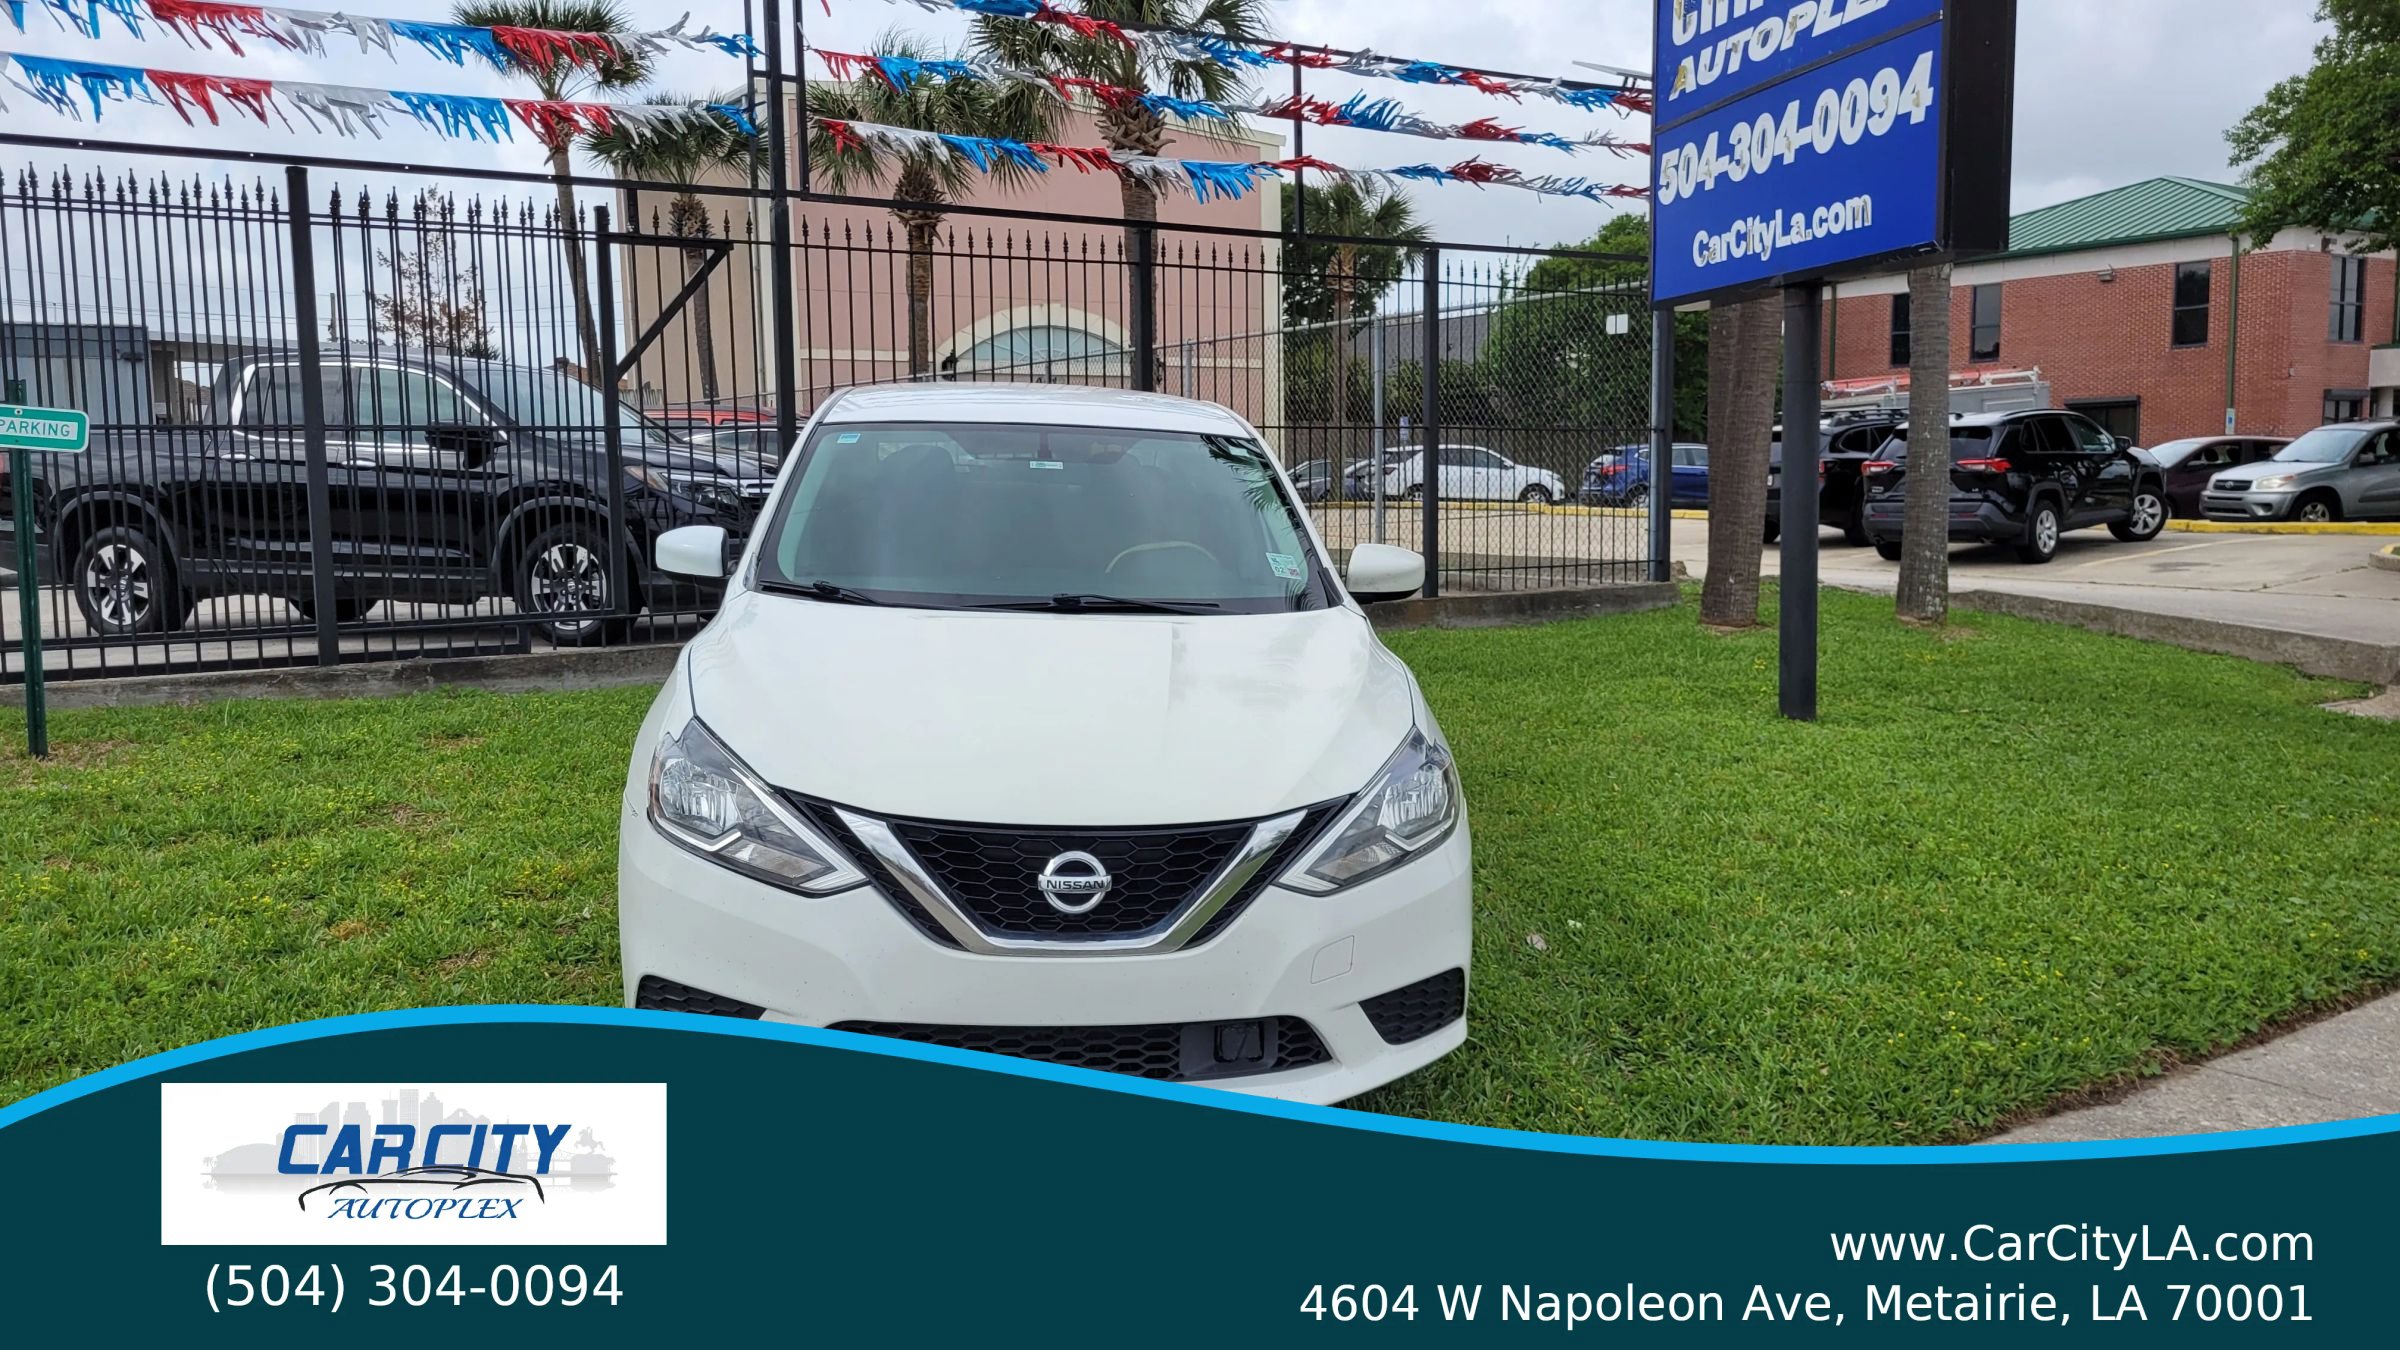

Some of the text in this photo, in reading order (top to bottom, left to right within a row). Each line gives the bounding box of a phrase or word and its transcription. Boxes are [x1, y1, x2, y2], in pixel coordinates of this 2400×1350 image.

[1668, 0, 1890, 102] AUTOPLE
[1657, 50, 1934, 205] 504-304-0094
[1692, 194, 1873, 268] CarCityLa.com
[1046, 880, 1104, 890] NISSAN
